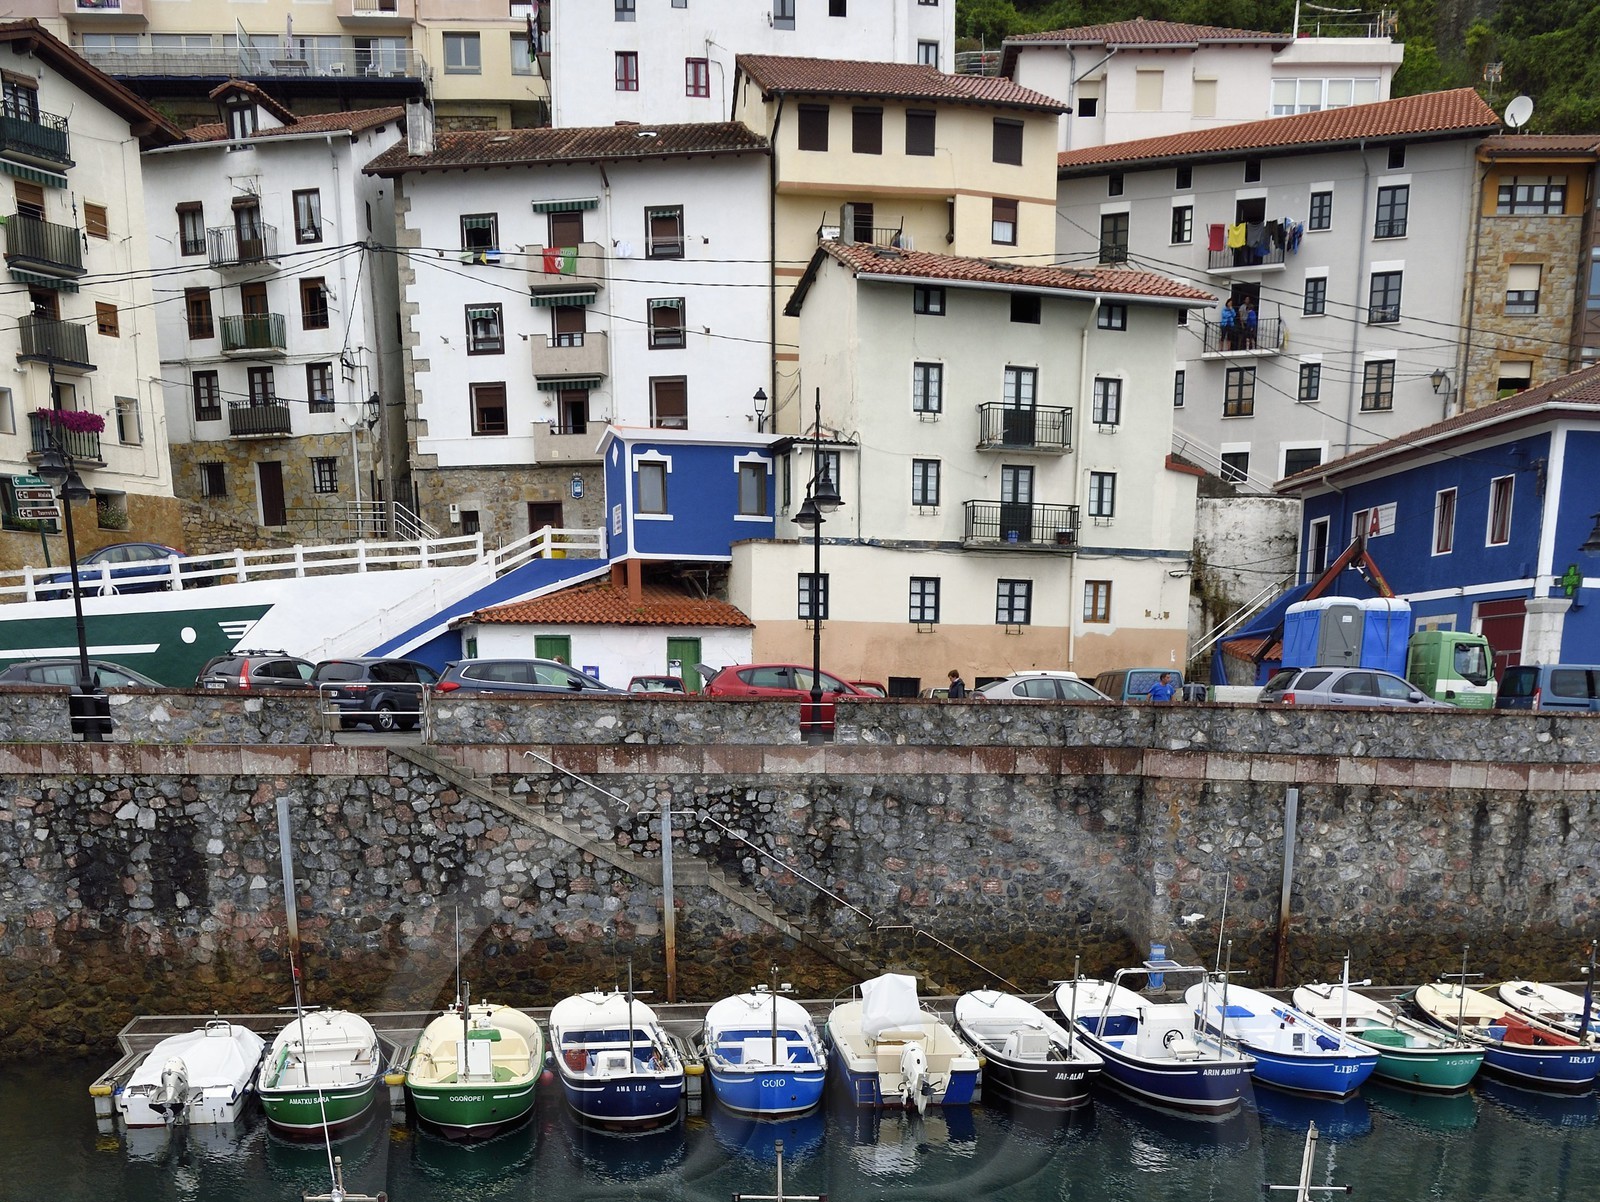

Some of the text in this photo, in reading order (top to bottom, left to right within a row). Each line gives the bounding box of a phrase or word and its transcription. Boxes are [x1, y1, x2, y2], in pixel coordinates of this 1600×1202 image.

[1569, 1056, 1595, 1064] IRATI
[1221, 1068, 1236, 1076] ARIN
[1334, 1064, 1359, 1074] LIBE
[1055, 1072, 1085, 1080] JAI-ALAI
[762, 1079, 786, 1088] GOIO
